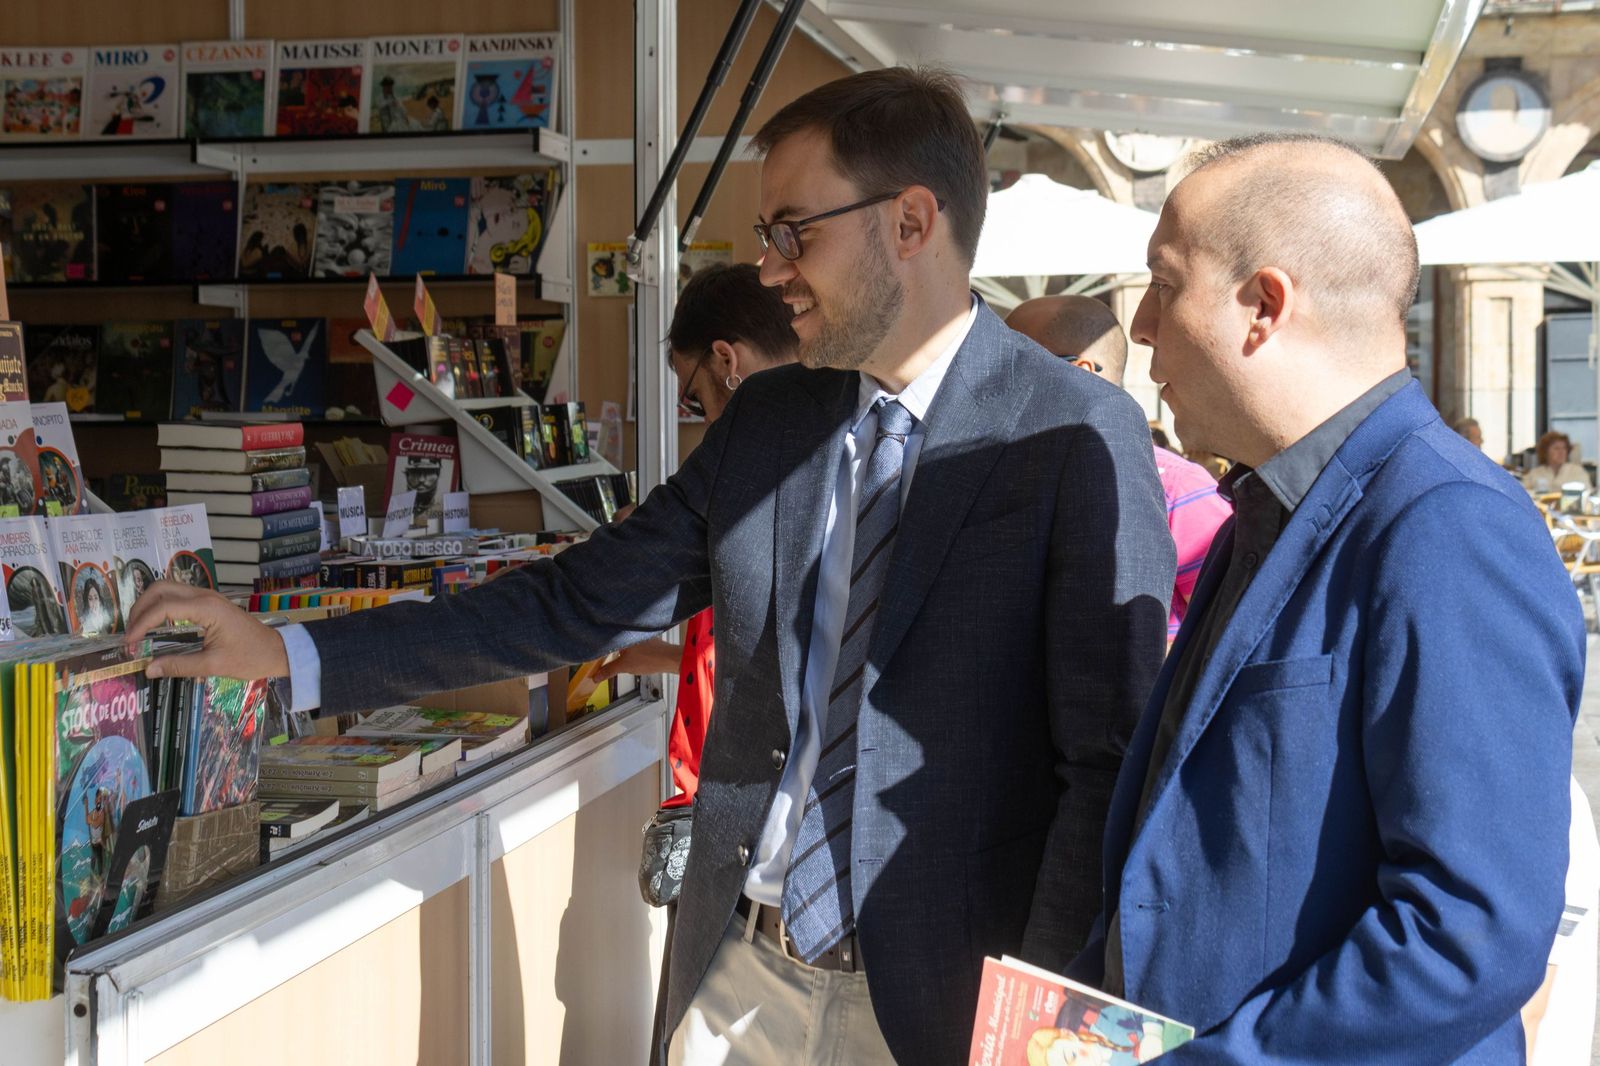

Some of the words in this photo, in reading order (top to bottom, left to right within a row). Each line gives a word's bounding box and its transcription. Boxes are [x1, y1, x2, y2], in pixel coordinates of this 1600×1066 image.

[281, 42, 363, 60] MATISSE
[372, 38, 447, 58] MONET
[468, 37, 556, 53] KANDINSKY
[2, 51, 53, 67] KLEE
[398, 437, 455, 454] Crimea
[340, 504, 364, 518] MÚSICA
[364, 543, 373, 556] A
[374, 541, 412, 560] TODO
[414, 540, 463, 556] RIESGO
[61, 700, 99, 739] STOCK
[99, 704, 110, 723] DE
[110, 686, 151, 724] COQUE
